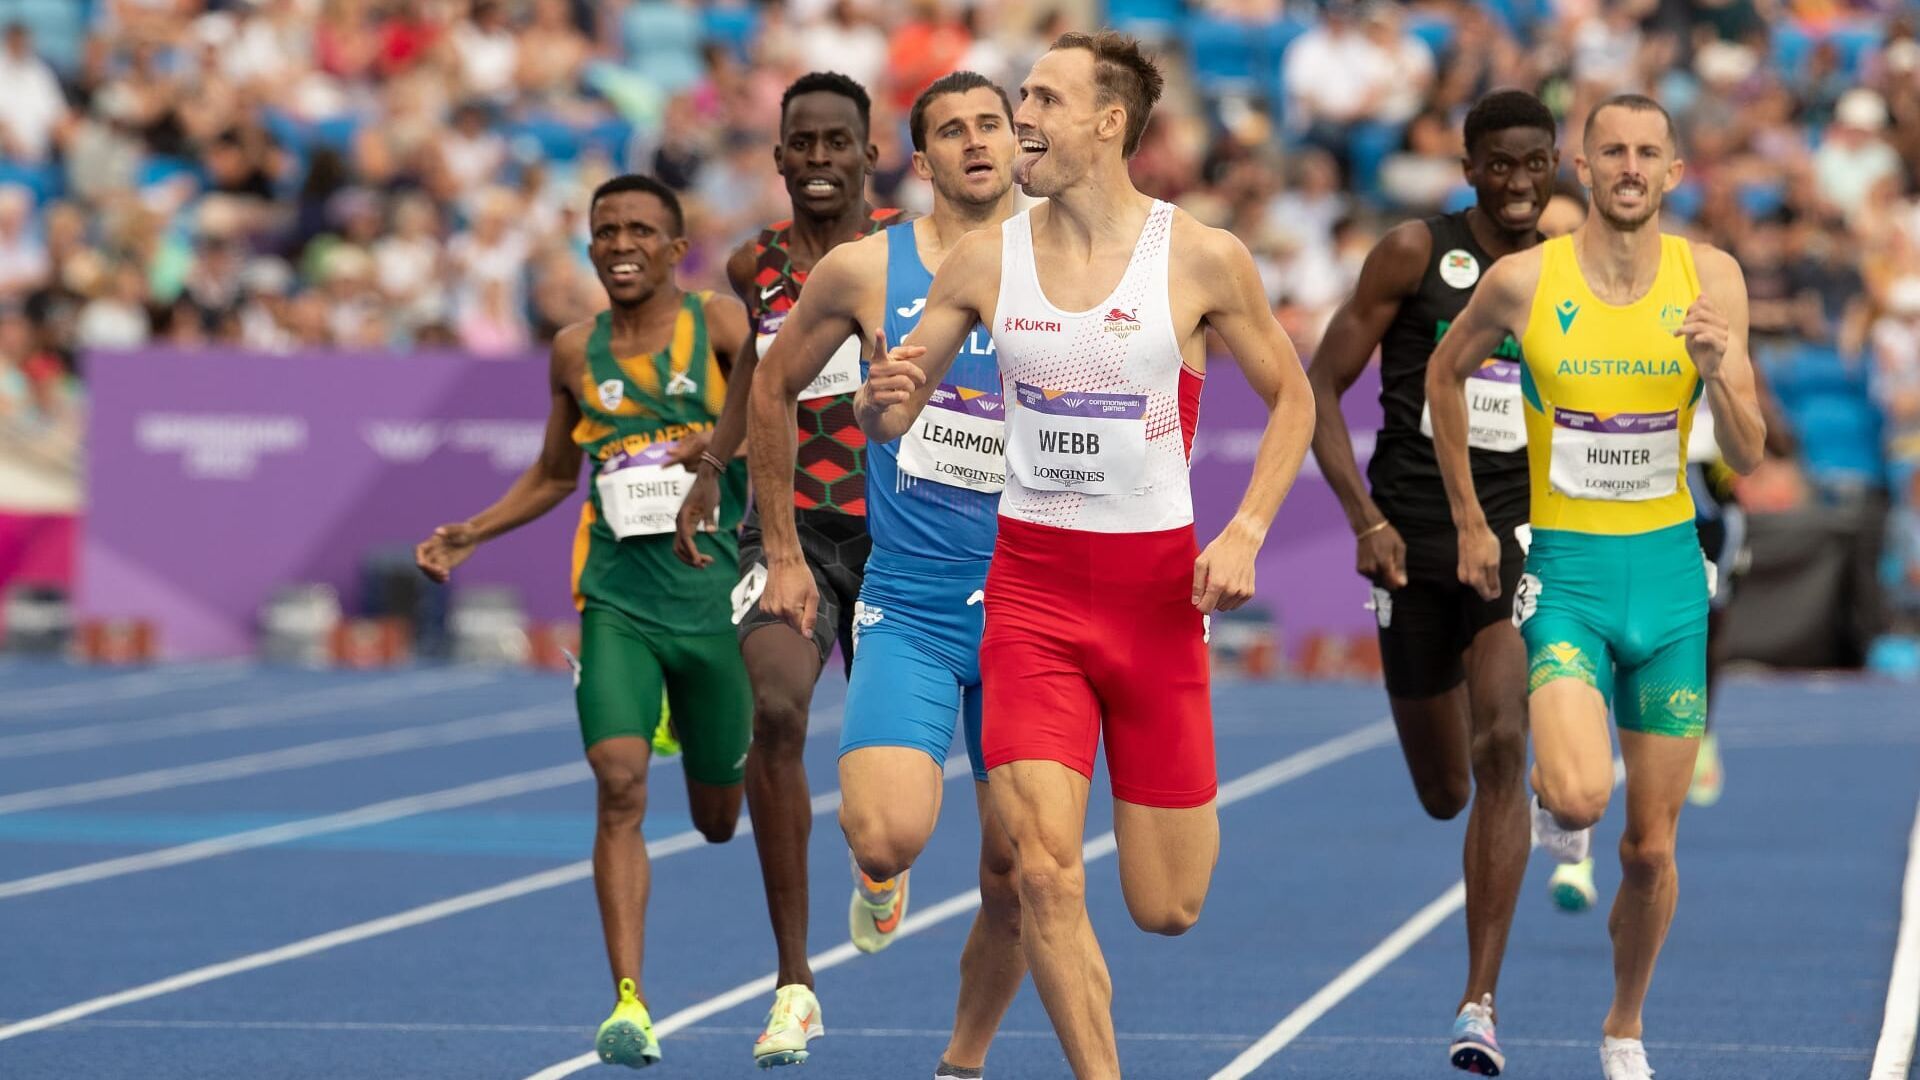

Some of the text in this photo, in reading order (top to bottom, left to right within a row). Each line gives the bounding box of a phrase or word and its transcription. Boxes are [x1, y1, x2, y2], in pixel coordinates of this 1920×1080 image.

[1014, 318, 1061, 332] KUKRI
[1103, 324, 1141, 333] ENGLAND
[1557, 359, 1682, 376] AUSTRALIA
[1088, 399, 1140, 407] commonwealth
[1102, 404, 1126, 412] games
[1472, 395, 1512, 415] LUKE
[1039, 429, 1101, 455] WEBB
[1586, 447, 1651, 466] HUNTER
[935, 460, 1006, 484] LONGINES
[1033, 465, 1105, 482] LONGINES
[626, 480, 681, 499] TSHITE
[1585, 478, 1651, 490] LONGINES
